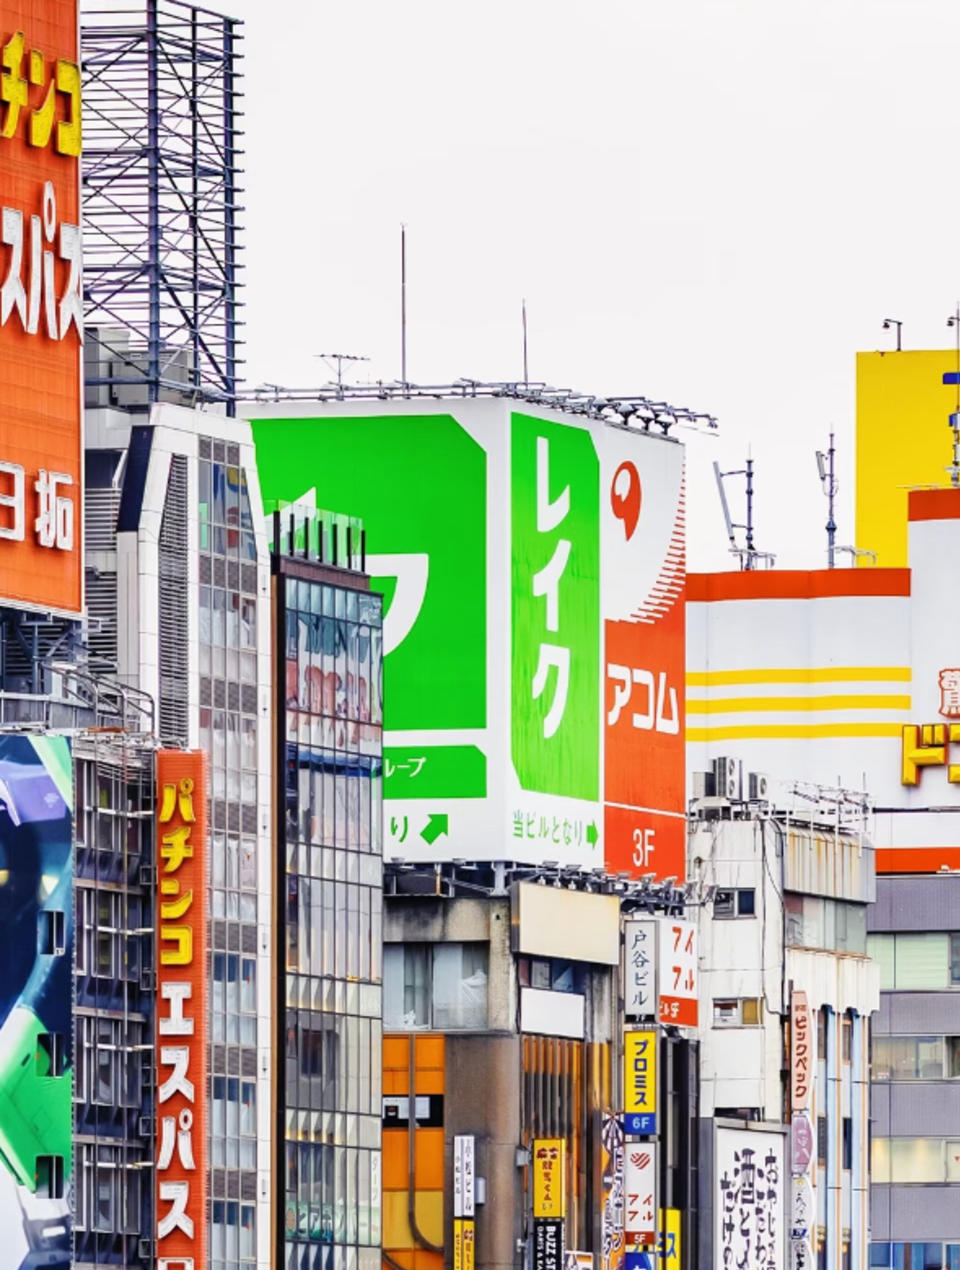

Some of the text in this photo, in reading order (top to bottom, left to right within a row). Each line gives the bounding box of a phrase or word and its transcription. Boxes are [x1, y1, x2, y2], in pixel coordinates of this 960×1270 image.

[532, 436, 572, 739] レイク
[607, 663, 680, 735] アコム
[513, 811, 583, 846] 当ビルとなり
[633, 829, 655, 867] 3F
[632, 929, 649, 1006] 戸谷ビル
[634, 1039, 648, 1106] プロミス
[632, 1117, 650, 1129] 6F
[546, 1226, 556, 1258] BUZZ
